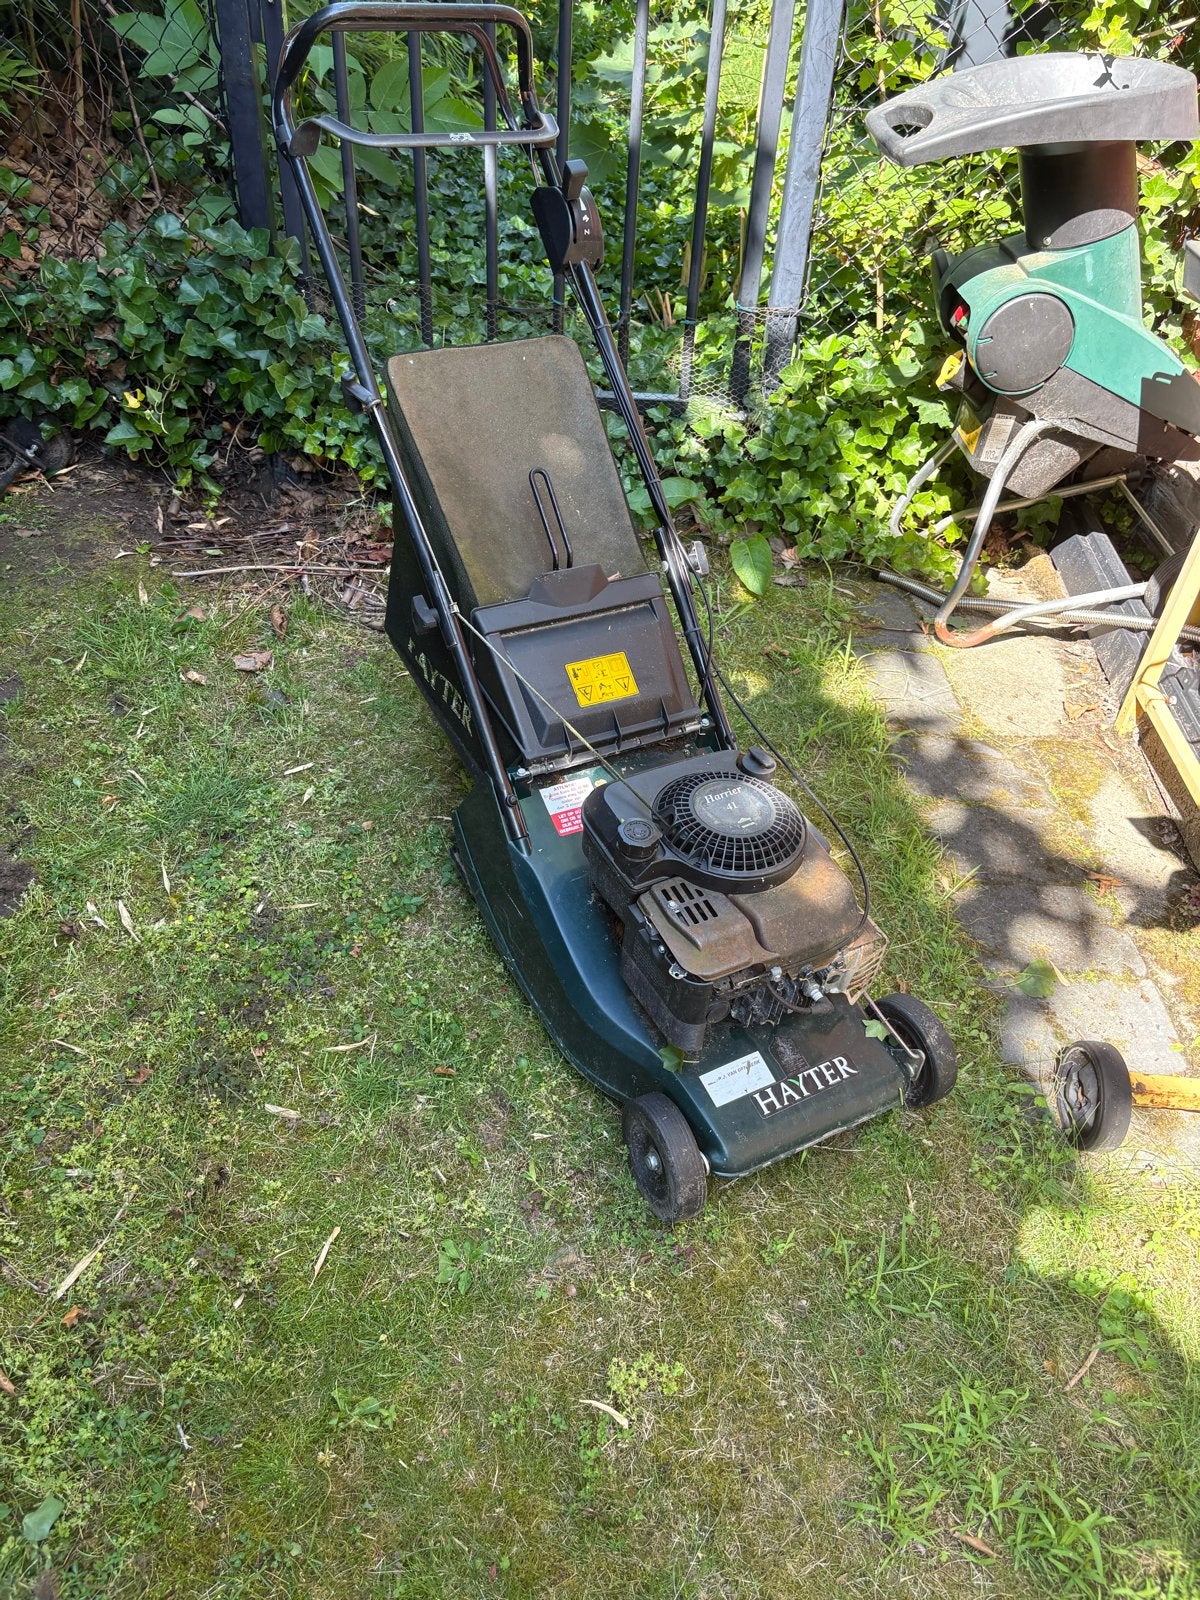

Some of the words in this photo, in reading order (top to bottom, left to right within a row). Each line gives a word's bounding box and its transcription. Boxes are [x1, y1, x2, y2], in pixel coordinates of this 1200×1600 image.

[704, 785, 742, 804] Harrier
[726, 801, 739, 811] 41
[753, 1056, 859, 1115] HAYTER
